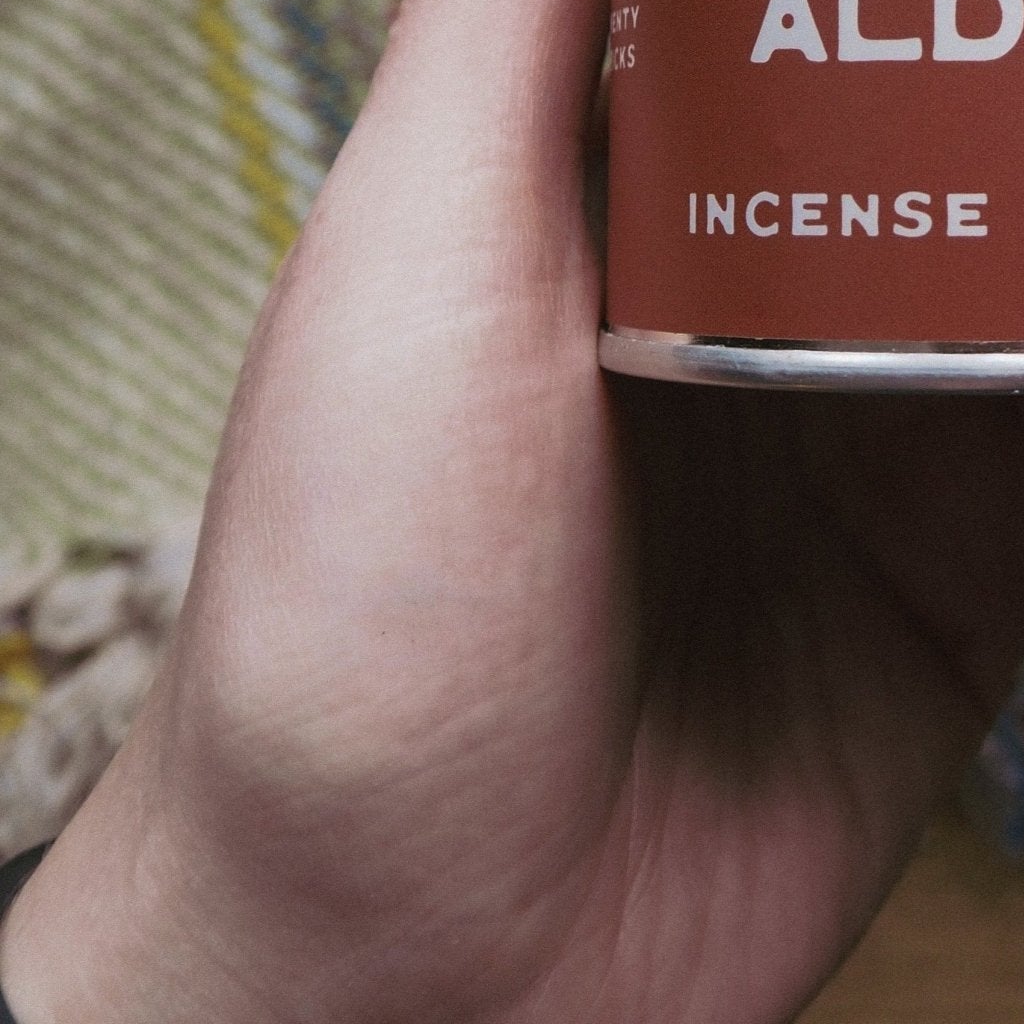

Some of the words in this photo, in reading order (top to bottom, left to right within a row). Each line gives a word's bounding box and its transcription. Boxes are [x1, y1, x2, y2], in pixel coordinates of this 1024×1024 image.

[610, 5, 640, 33] ENTY
[612, 43, 636, 70] CKS
[688, 190, 988, 238] INCENSE
